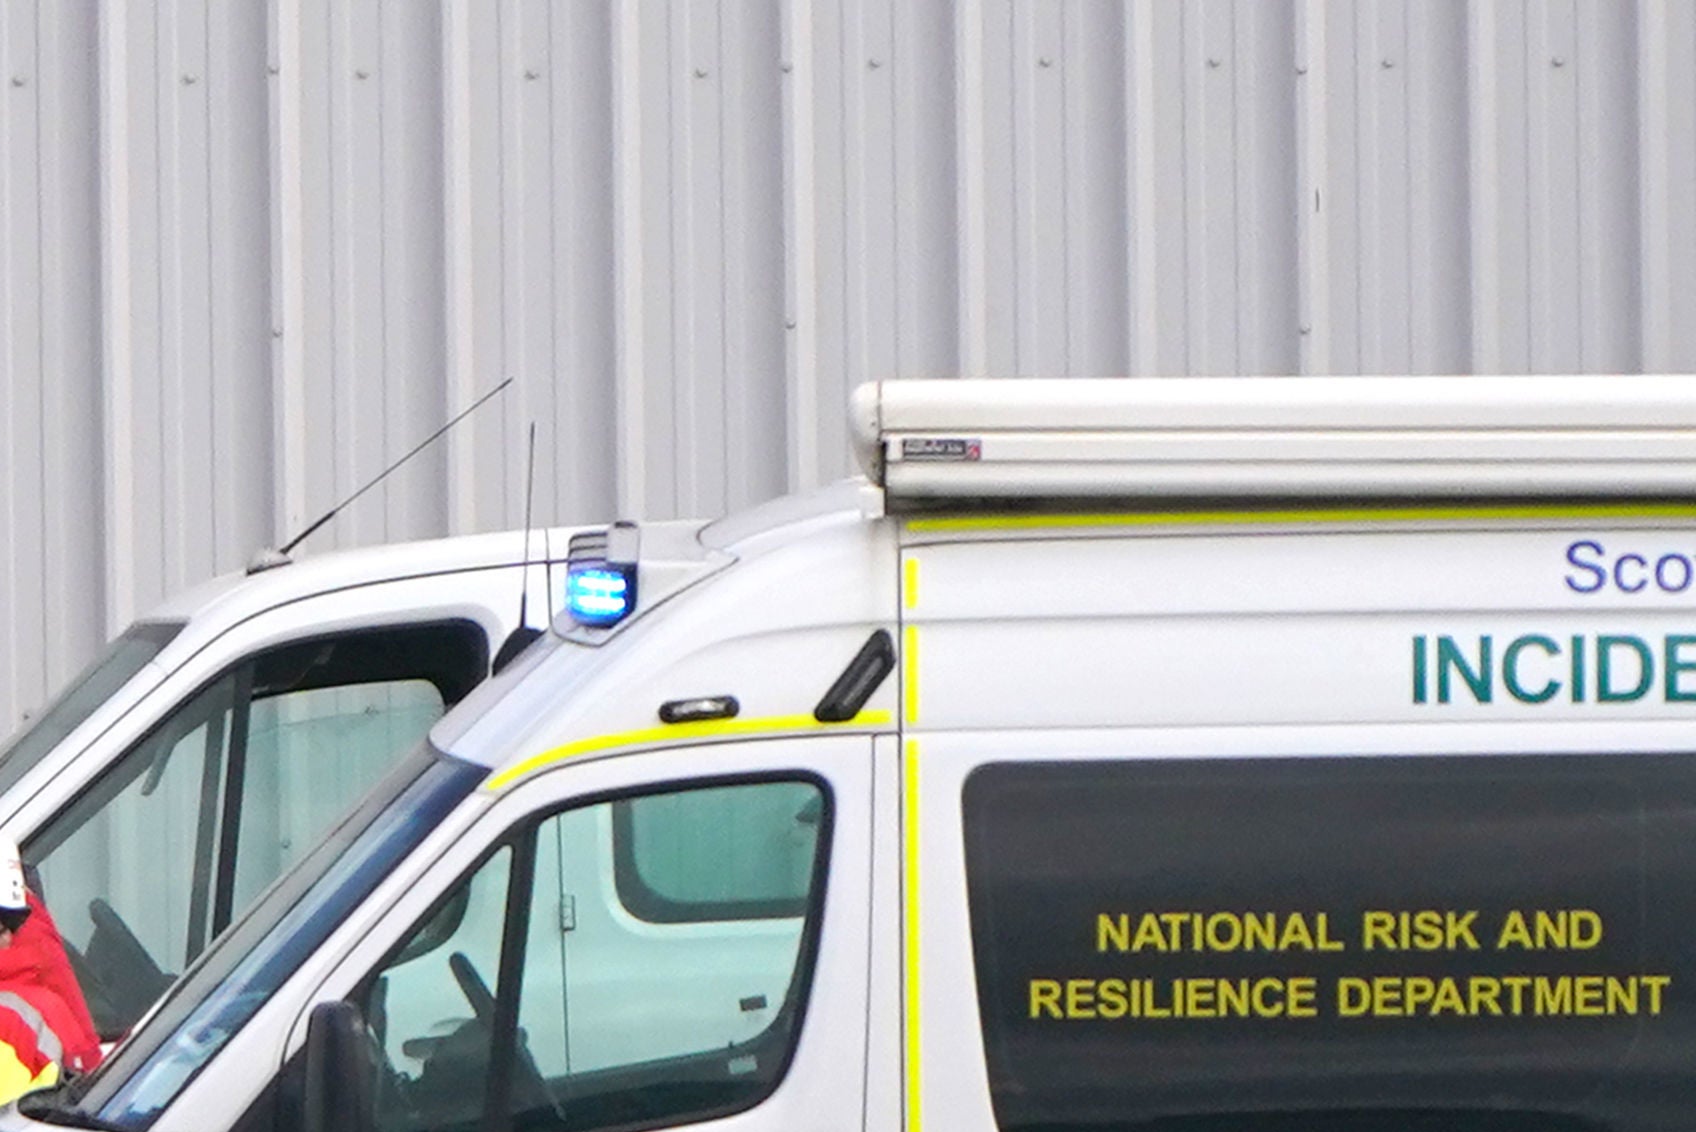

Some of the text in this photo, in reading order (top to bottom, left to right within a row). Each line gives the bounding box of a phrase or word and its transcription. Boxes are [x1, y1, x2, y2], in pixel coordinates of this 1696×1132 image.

[1565, 539, 1696, 593] Sco
[1097, 910, 1603, 952] NATIONAL RISK AND
[1029, 975, 1671, 1019] RESILIENCE DEPARTMENT
